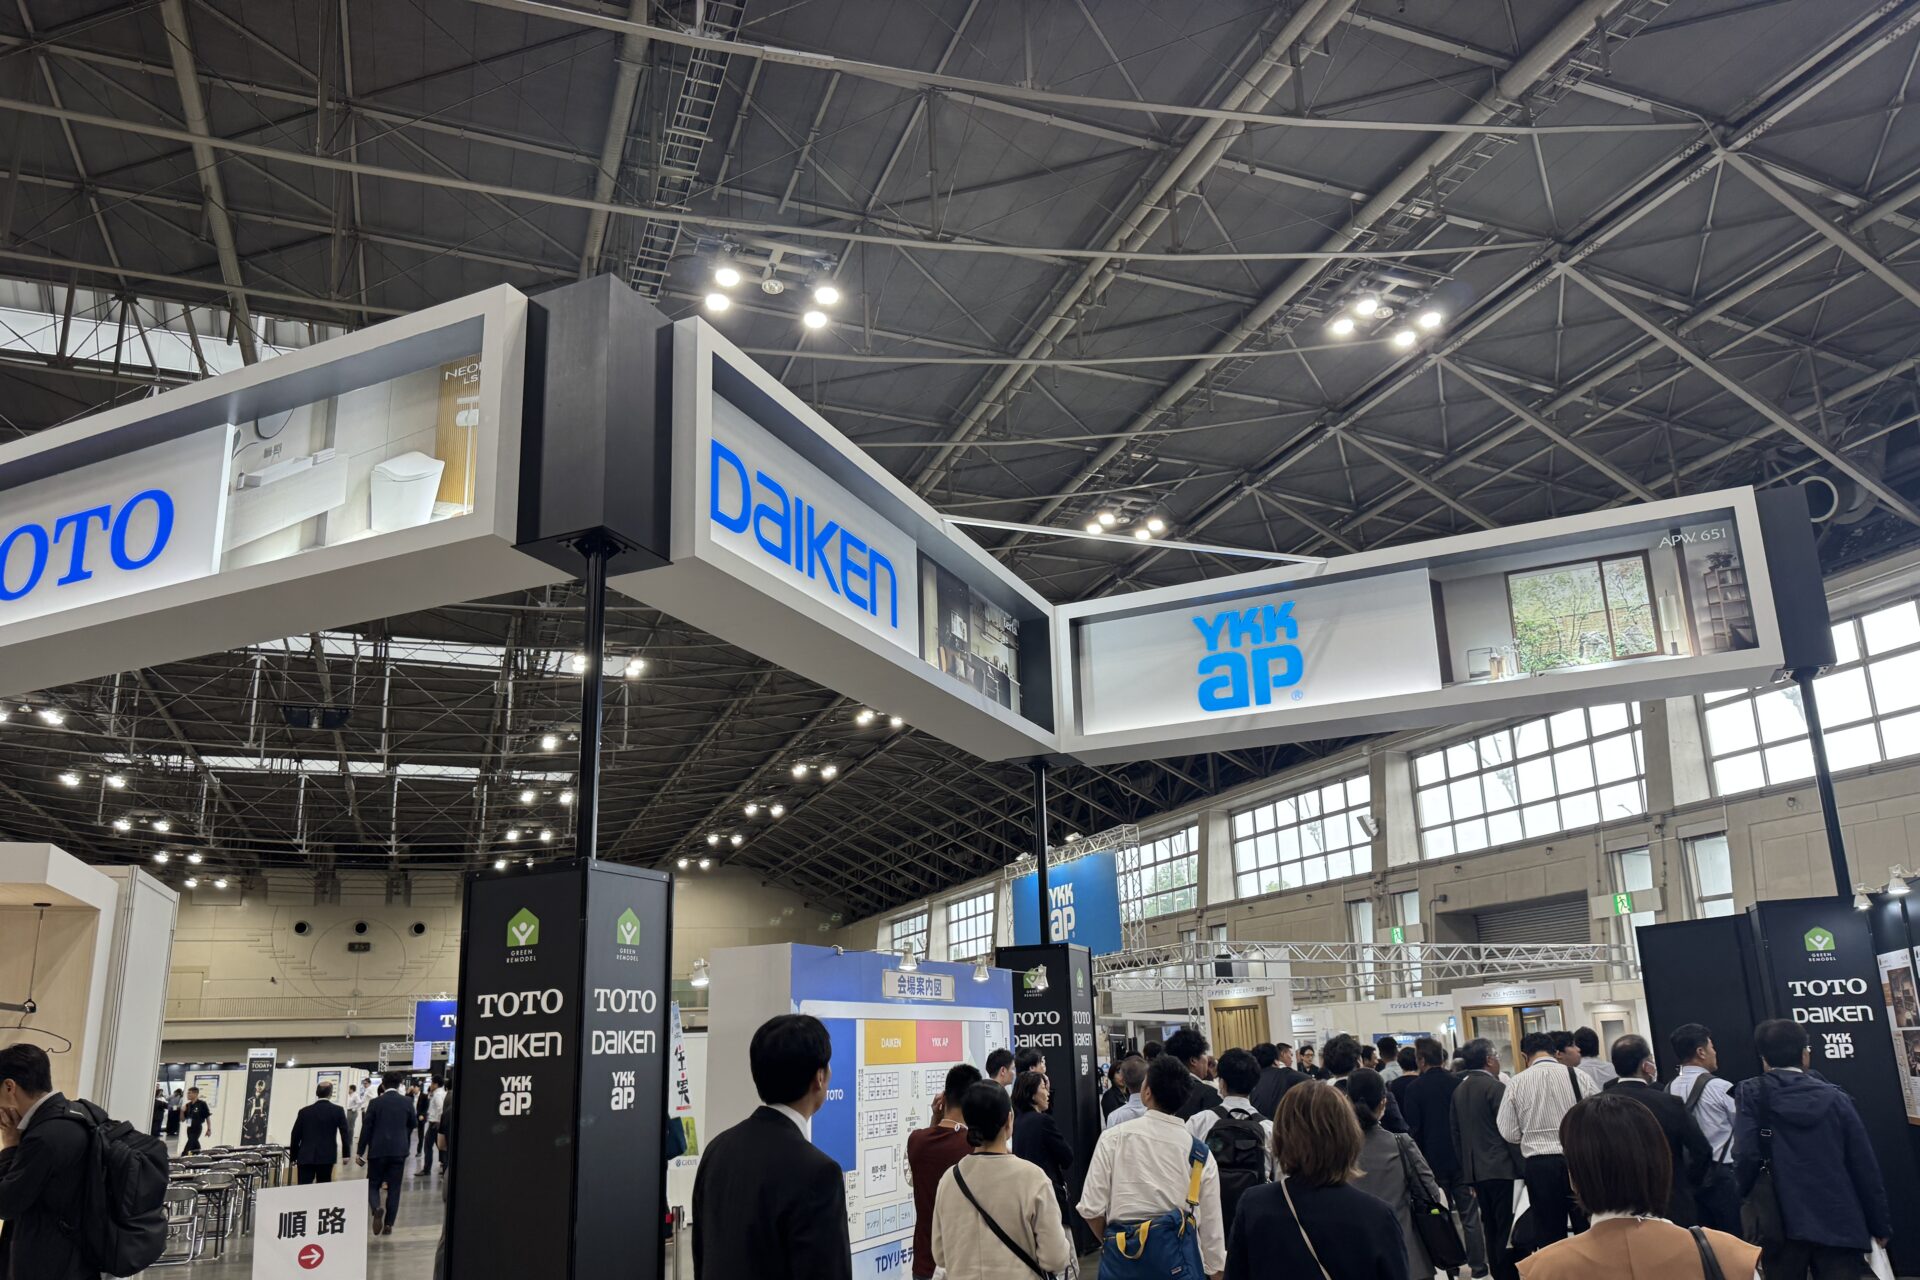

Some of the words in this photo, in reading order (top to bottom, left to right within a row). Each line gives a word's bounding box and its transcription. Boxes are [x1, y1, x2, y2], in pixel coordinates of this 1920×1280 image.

[445, 362, 481, 380] NEO
[1658, 532, 1697, 549] APW
[1701, 528, 1726, 540] 651
[1192, 600, 1299, 652] YKK
[1049, 882, 1074, 908] YKK
[510, 949, 533, 957] GREEN
[616, 954, 639, 962] REMODEL
[619, 947, 636, 955] GREEN
[506, 955, 537, 964] REMODEL
[897, 974, 942, 996] 会場案内図
[1788, 978, 1868, 997] TOTO
[477, 988, 564, 1019] TOTO
[594, 988, 657, 1014] TOTO
[440, 1014, 457, 1028] T
[1013, 1010, 1060, 1026] TOTO
[1073, 1010, 1091, 1025] TOTO
[881, 1037, 902, 1048] DAIKEN
[932, 1037, 942, 1047] YKK
[1821, 1032, 1853, 1044] YKK
[500, 1075, 533, 1092] YKK
[611, 1071, 636, 1087] YKK
[826, 1089, 844, 1101] TOTO
[277, 1207, 346, 1240] 順路
